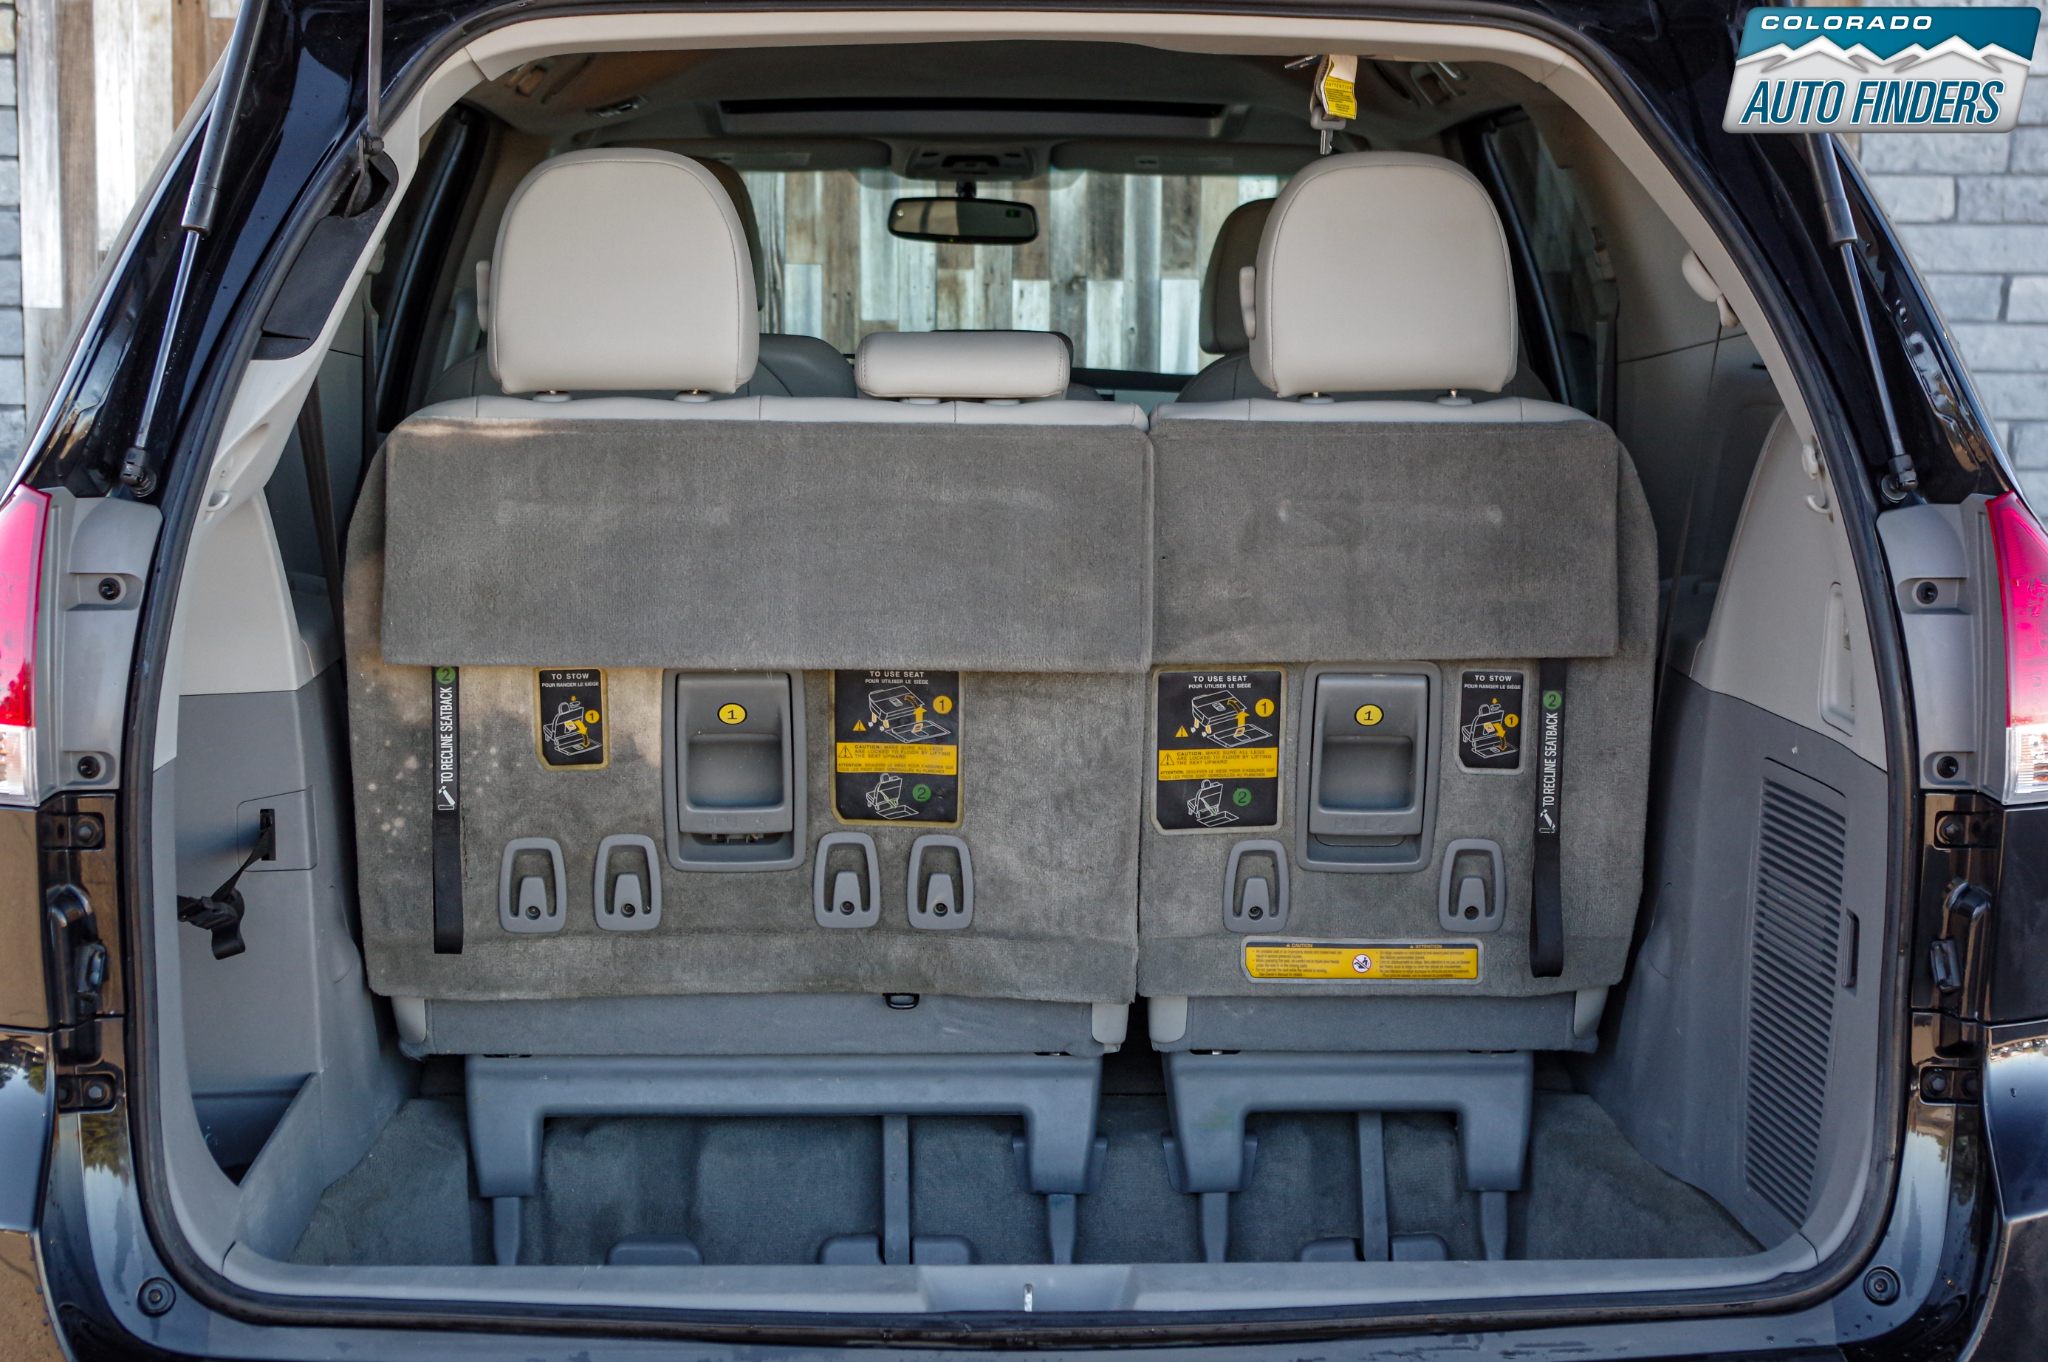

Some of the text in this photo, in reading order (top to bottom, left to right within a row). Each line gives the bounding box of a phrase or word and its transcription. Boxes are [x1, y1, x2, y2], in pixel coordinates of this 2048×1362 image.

[441, 669, 450, 681] 2
[939, 699, 944, 711] 1
[1548, 694, 1556, 707] 2
[1262, 702, 1267, 714] 1
[727, 710, 737, 719] 1
[1363, 710, 1373, 721] 1
[440, 687, 453, 783] TO RECLINE SEATBACK
[1542, 712, 1558, 807] TO RECLINE SEATBACK
[917, 787, 926, 799] 2
[1238, 791, 1247, 803] 2
